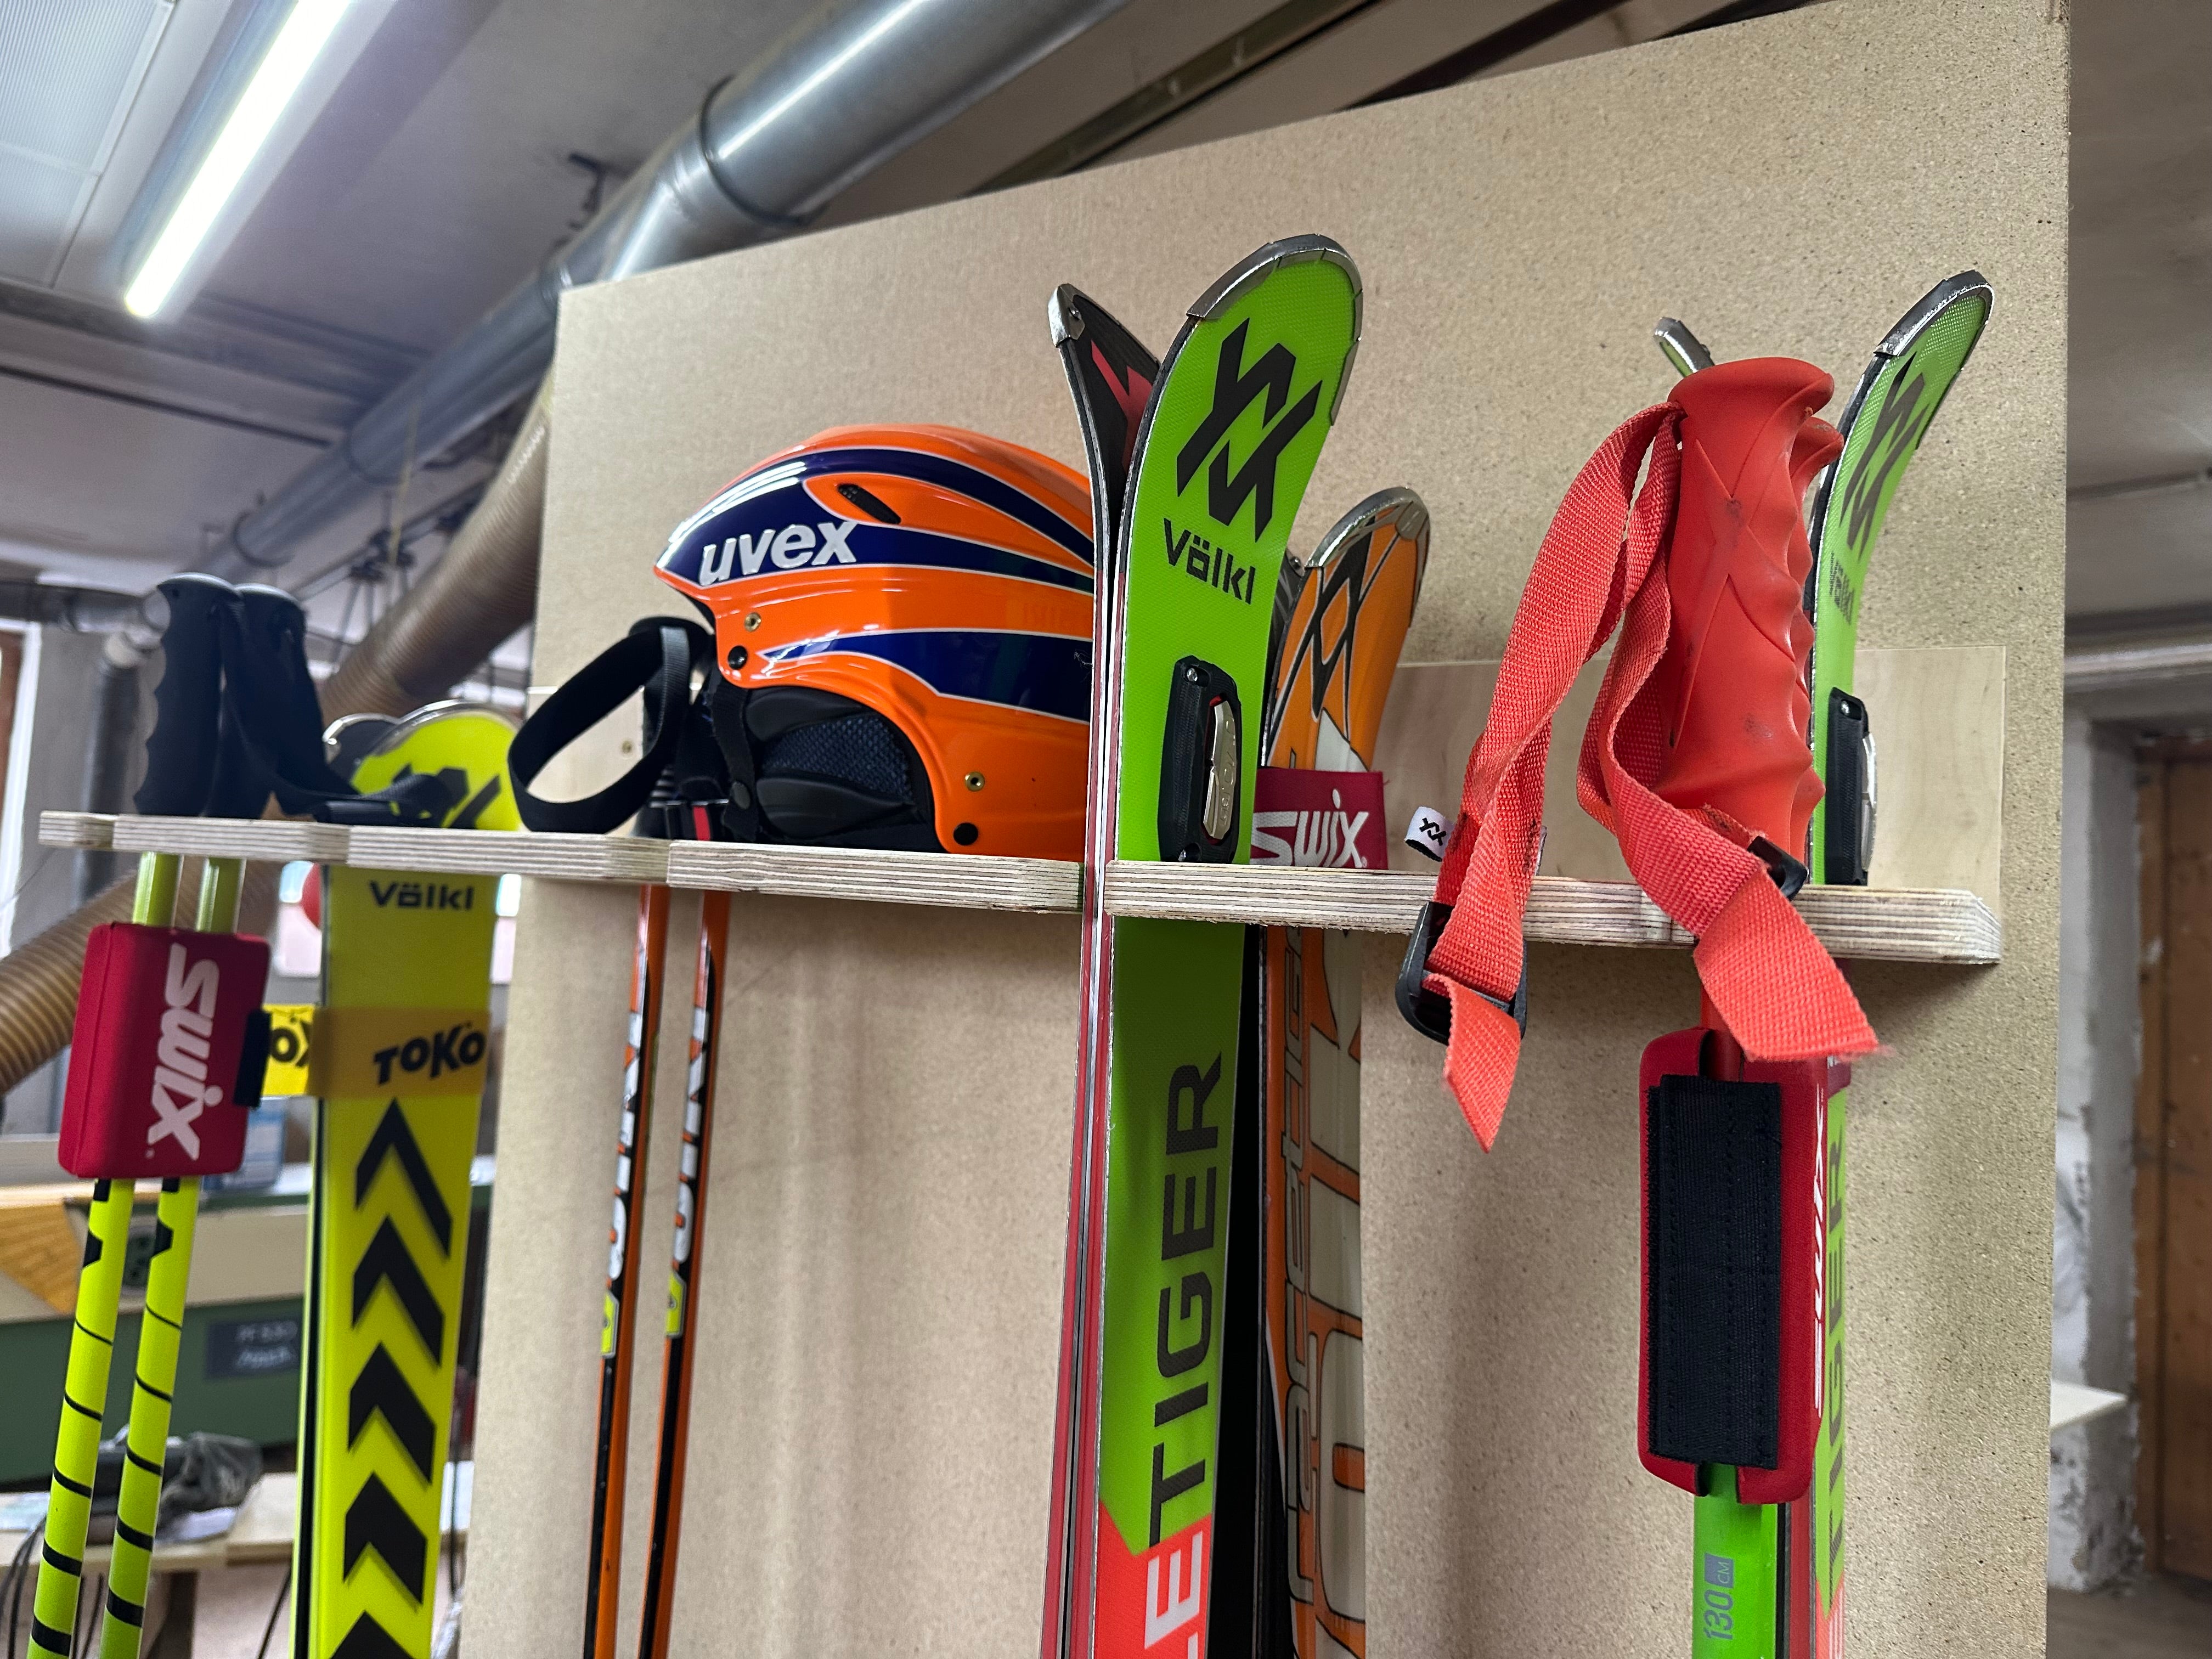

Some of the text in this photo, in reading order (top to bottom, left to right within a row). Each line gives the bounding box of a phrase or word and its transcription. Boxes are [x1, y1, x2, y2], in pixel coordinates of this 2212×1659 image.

[698, 520, 857, 585] uvex
[1163, 517, 1256, 605] Völkl
[369, 880, 474, 911] Völkl
[1702, 1561, 1734, 1640] 130 CM
